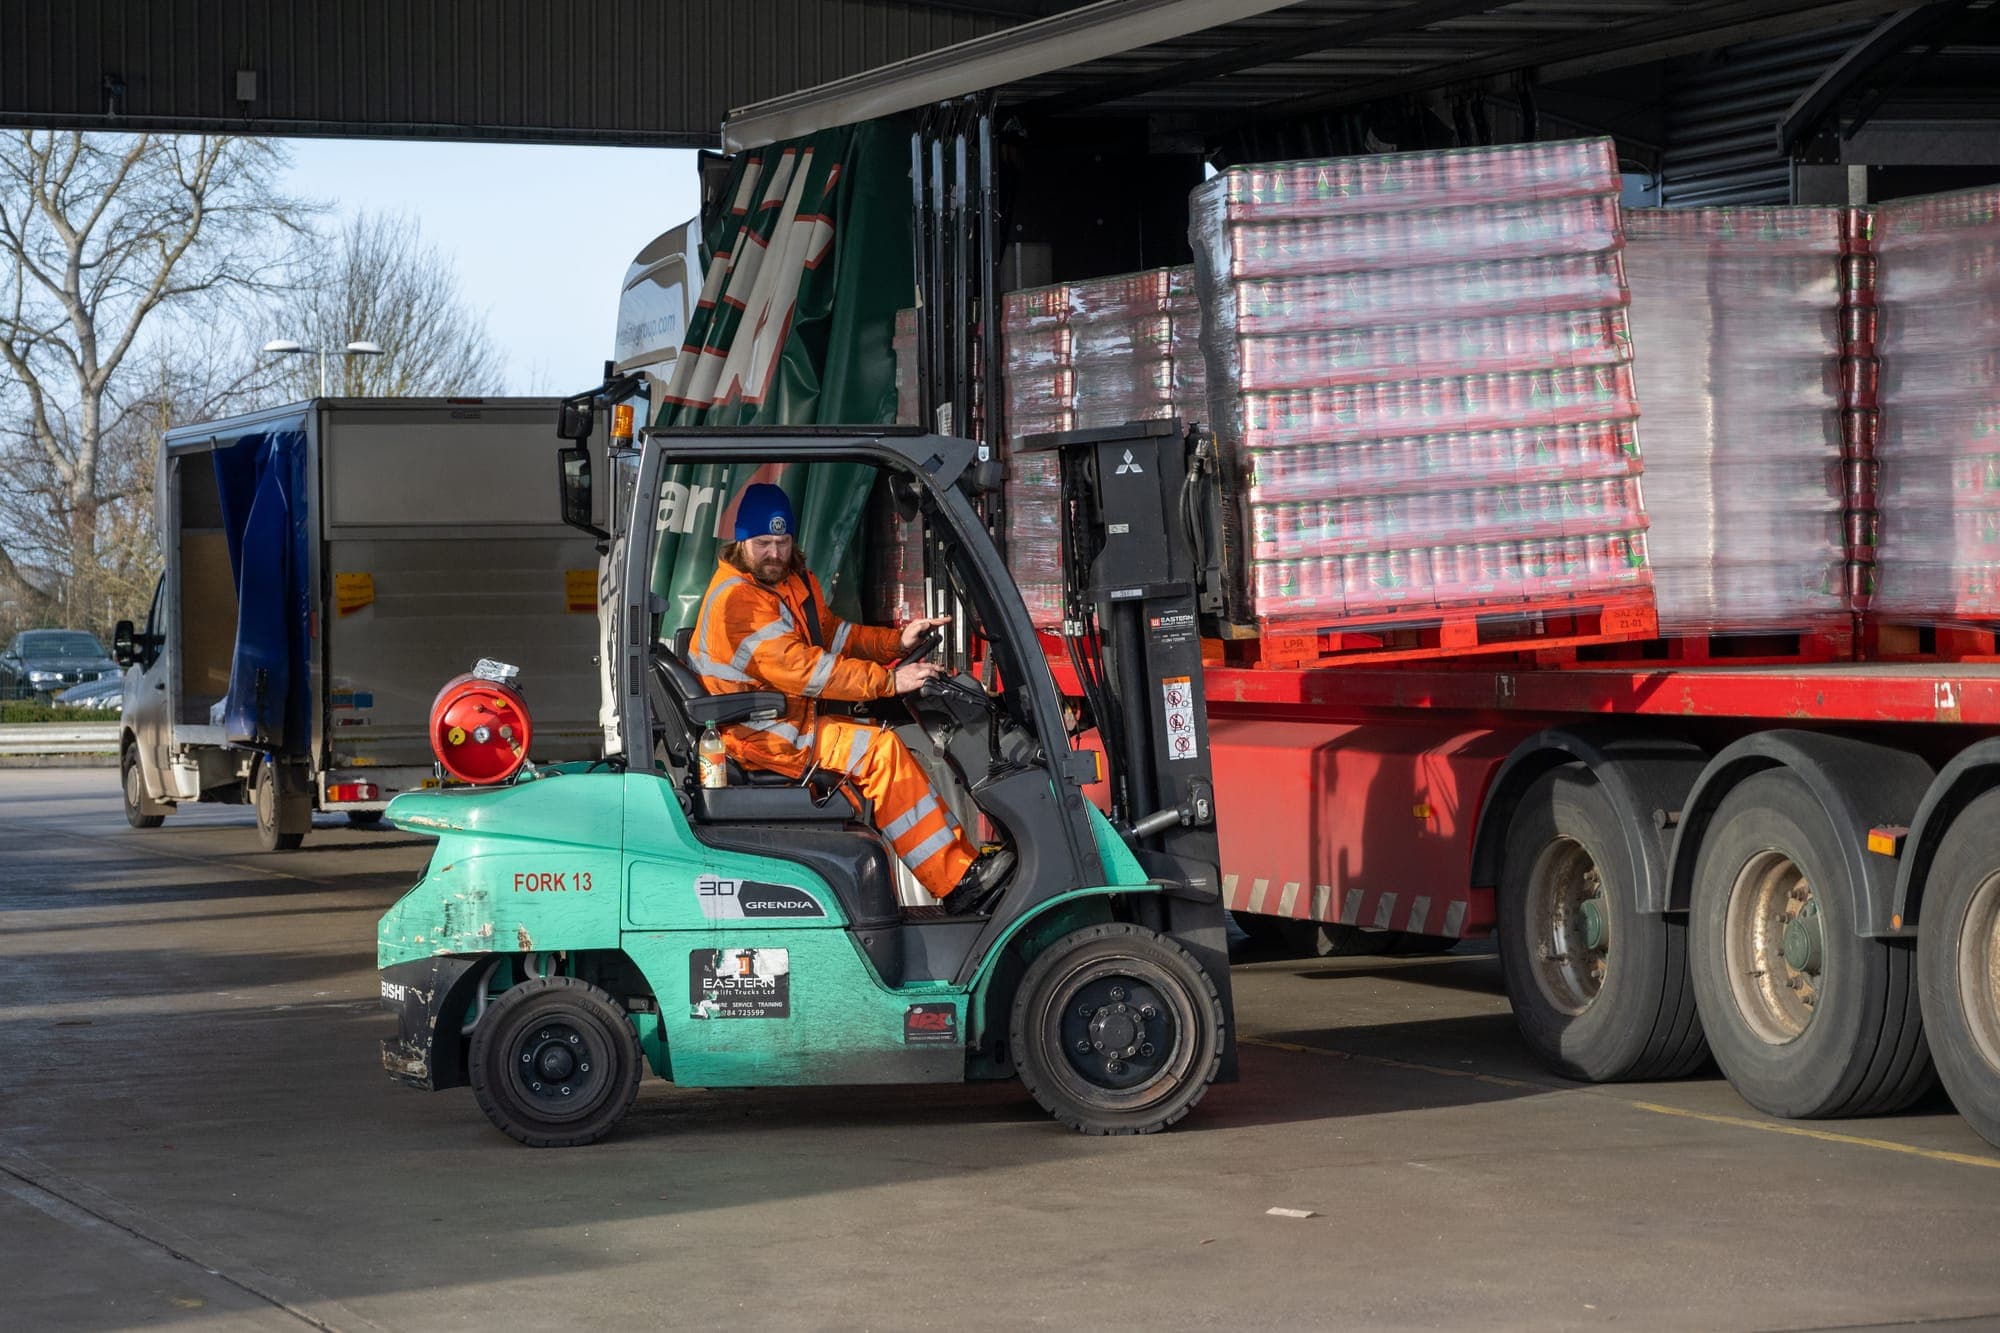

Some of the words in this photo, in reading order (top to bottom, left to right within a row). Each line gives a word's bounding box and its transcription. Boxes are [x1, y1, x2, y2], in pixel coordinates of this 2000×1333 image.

[1160, 615, 1193, 623] EASTERN
[1283, 639, 1304, 649] LPR
[514, 872, 567, 892] FORK
[572, 872, 592, 891] 13
[700, 881, 734, 896] 30
[745, 901, 813, 909] GRENDIA
[703, 978, 776, 988] EASTERN
